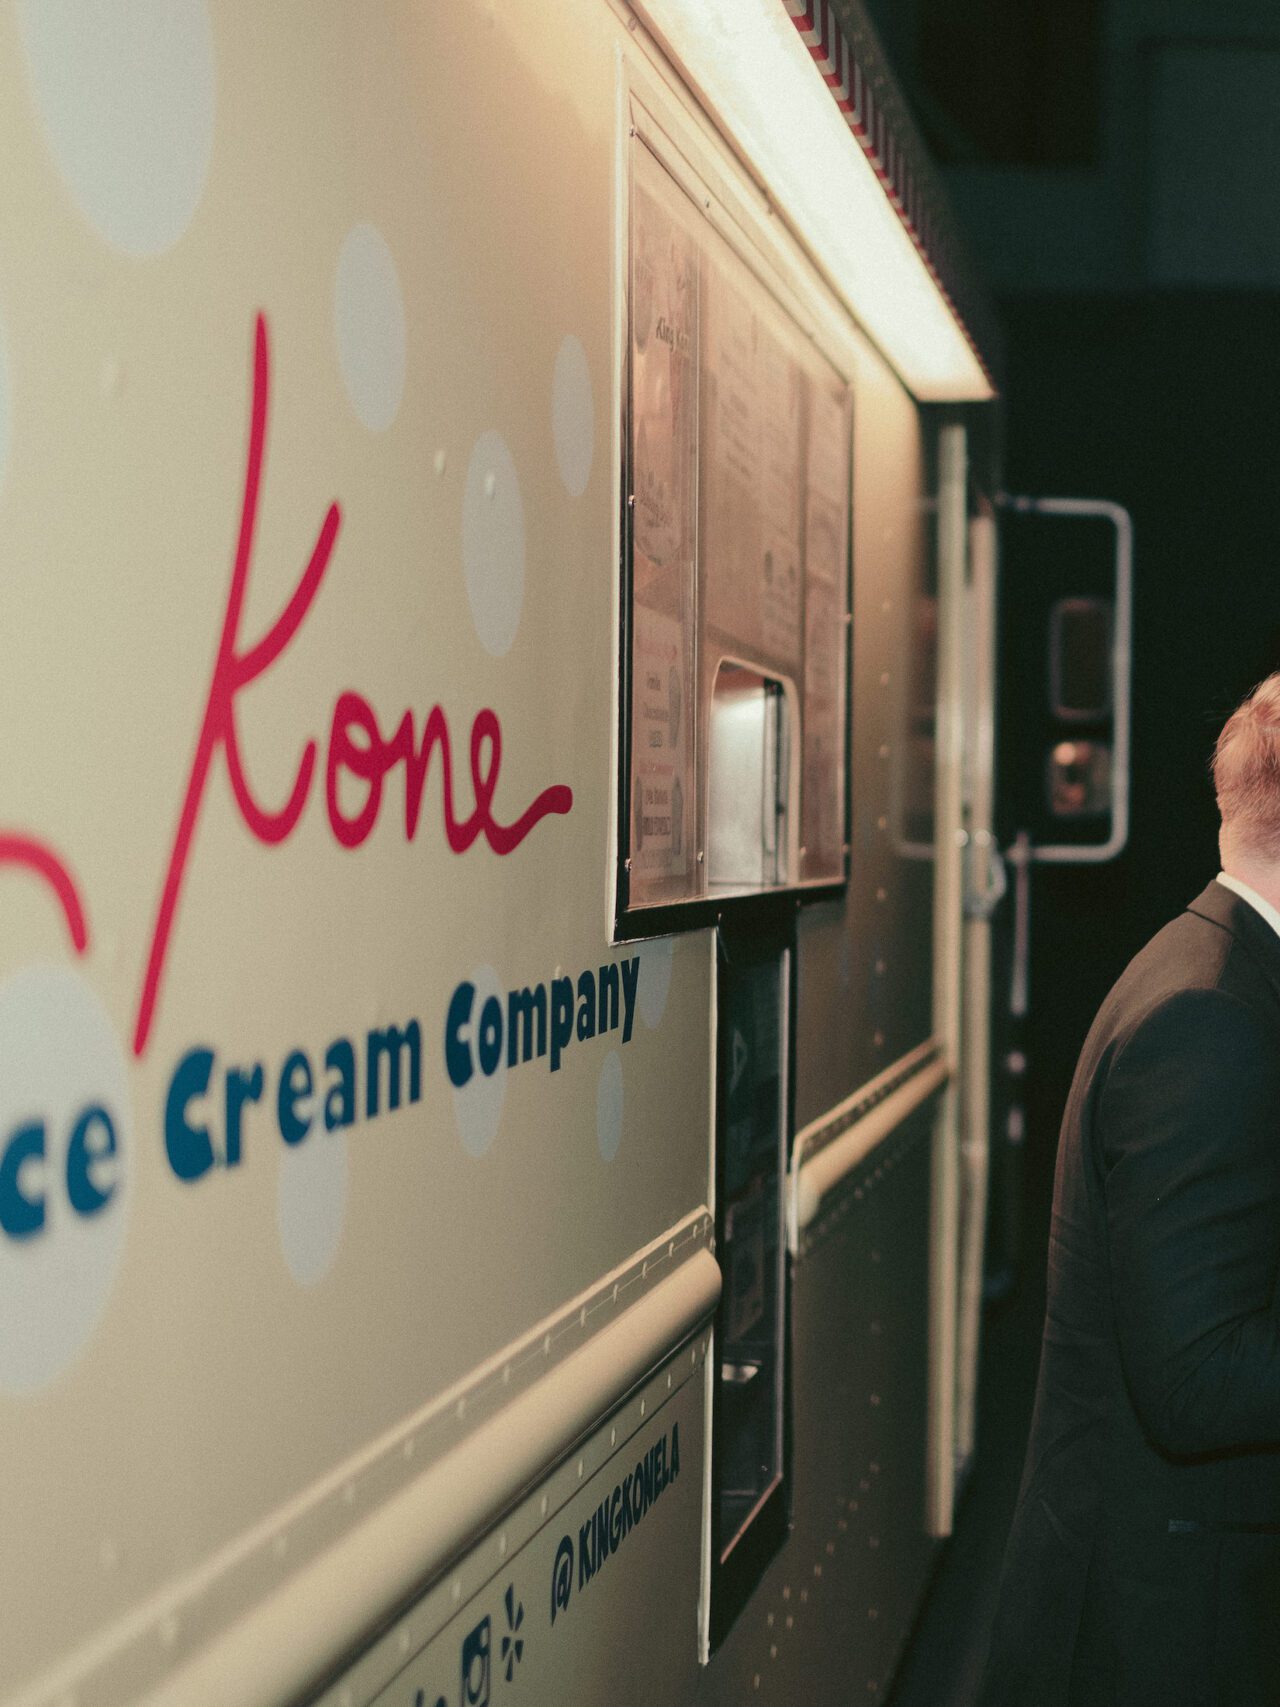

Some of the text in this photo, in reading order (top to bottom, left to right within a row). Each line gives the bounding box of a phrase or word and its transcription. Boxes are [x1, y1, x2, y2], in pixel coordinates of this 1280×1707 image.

[131, 312, 574, 1059] Kone
[0, 955, 641, 1238] ce Cream Company
